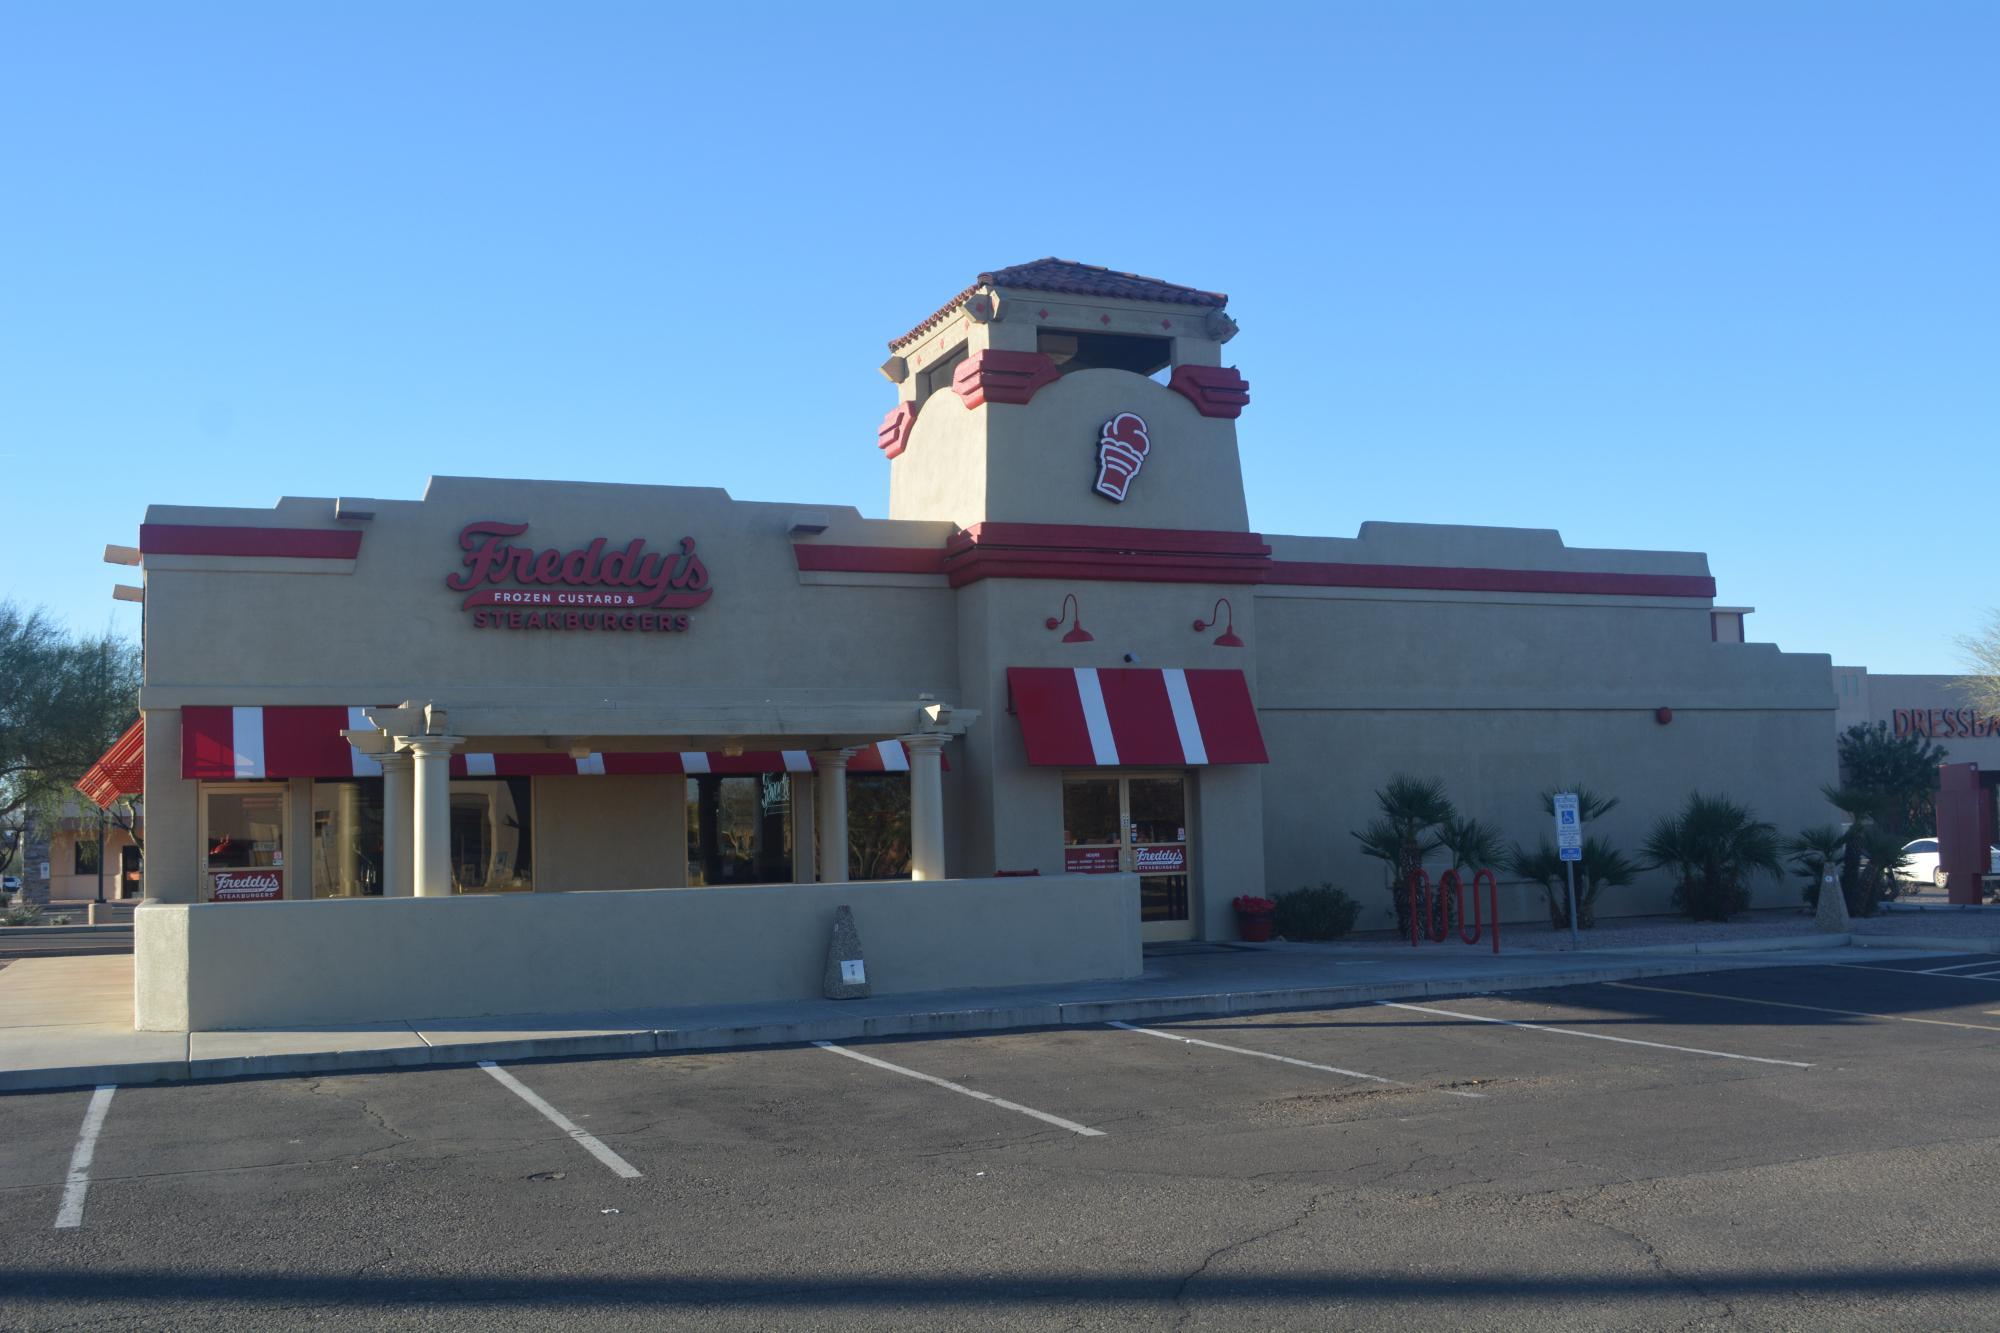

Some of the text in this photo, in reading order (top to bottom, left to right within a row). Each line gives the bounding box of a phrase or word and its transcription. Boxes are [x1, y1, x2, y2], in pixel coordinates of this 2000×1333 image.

[447, 521, 711, 604] Freddy's
[494, 592, 635, 604] FROZEN CUSTARD &
[473, 608, 691, 632] STEAKBURGERS
[1135, 847, 1184, 865] Freddy's
[215, 873, 279, 893] Freddy's
